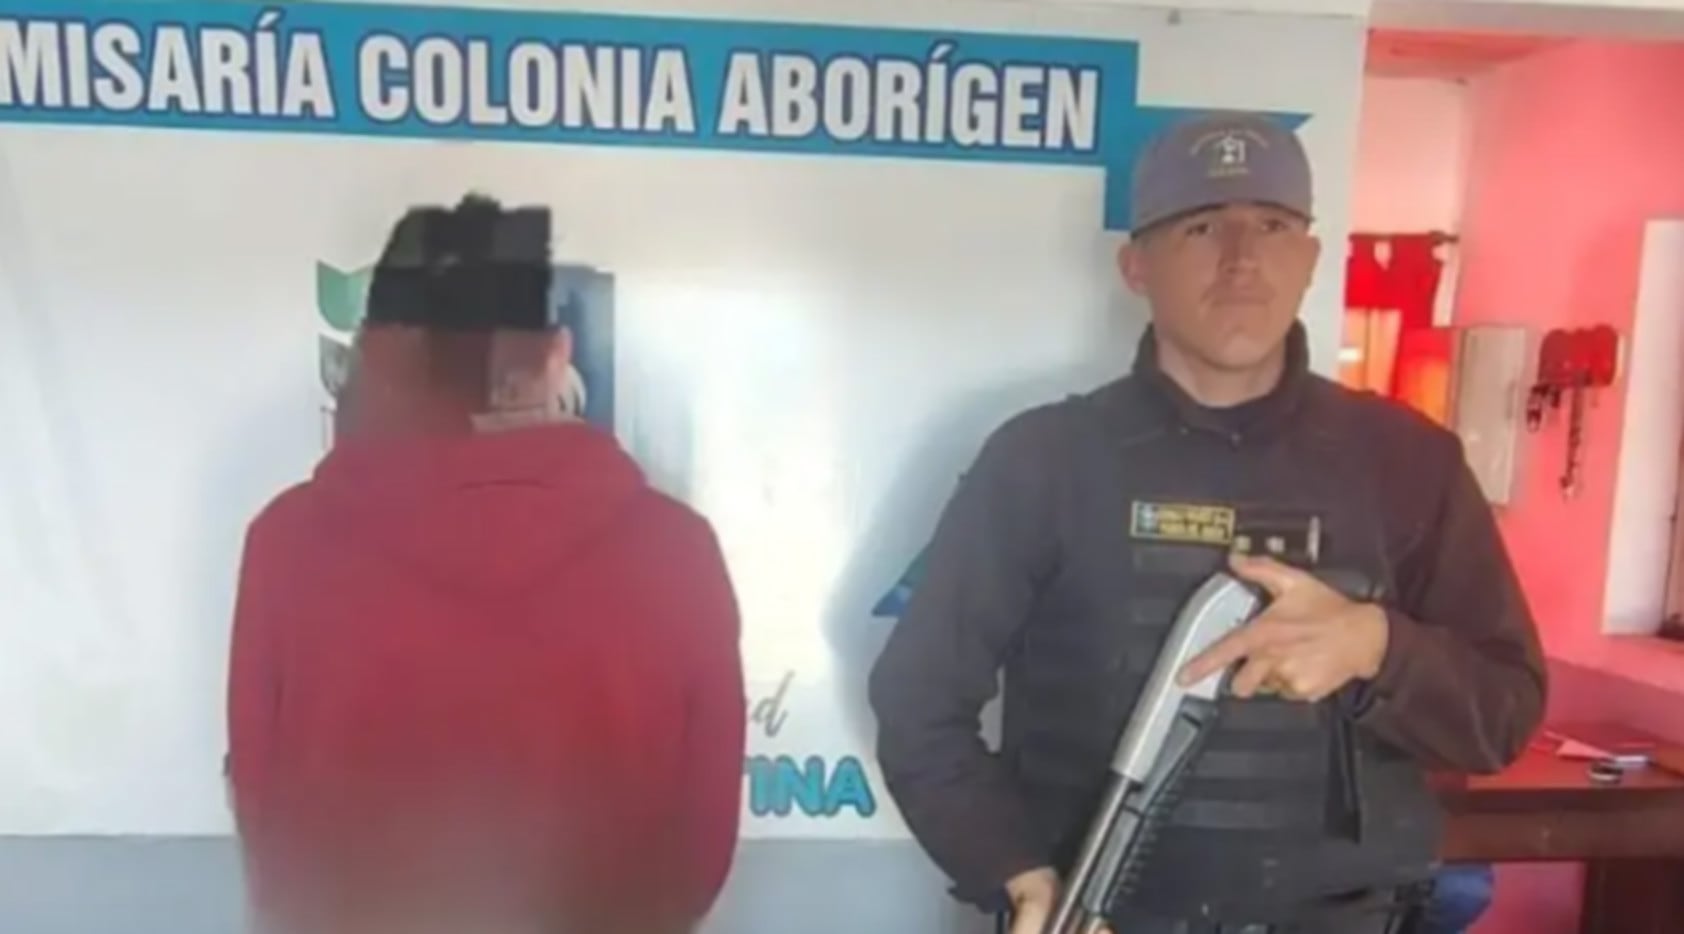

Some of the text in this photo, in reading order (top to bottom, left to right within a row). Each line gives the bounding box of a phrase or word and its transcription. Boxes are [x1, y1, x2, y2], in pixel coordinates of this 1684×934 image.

[0, 13, 1098, 150] MISARÍA COLONIA ABORÍGEN
[746, 756, 875, 818] INA
